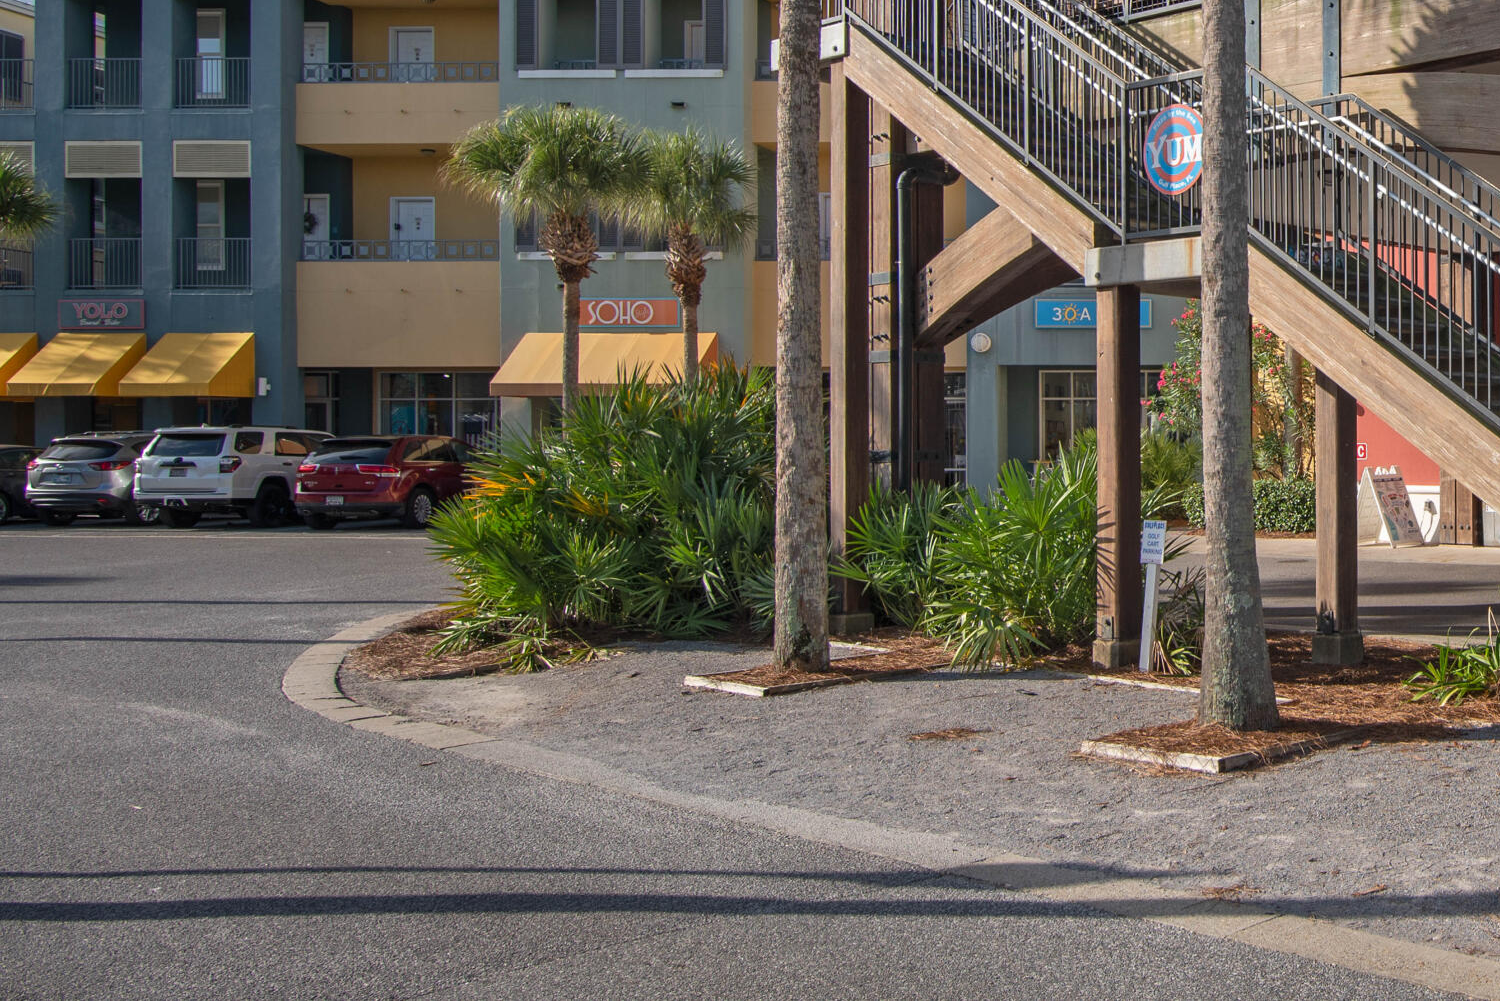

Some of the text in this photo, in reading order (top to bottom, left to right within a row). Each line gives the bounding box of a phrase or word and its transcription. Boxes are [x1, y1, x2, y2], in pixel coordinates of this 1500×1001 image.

[1146, 133, 1203, 169] YUM
[72, 302, 128, 319] YOLO
[587, 300, 654, 325] SOHO
[1051, 303, 1092, 324] 30A
